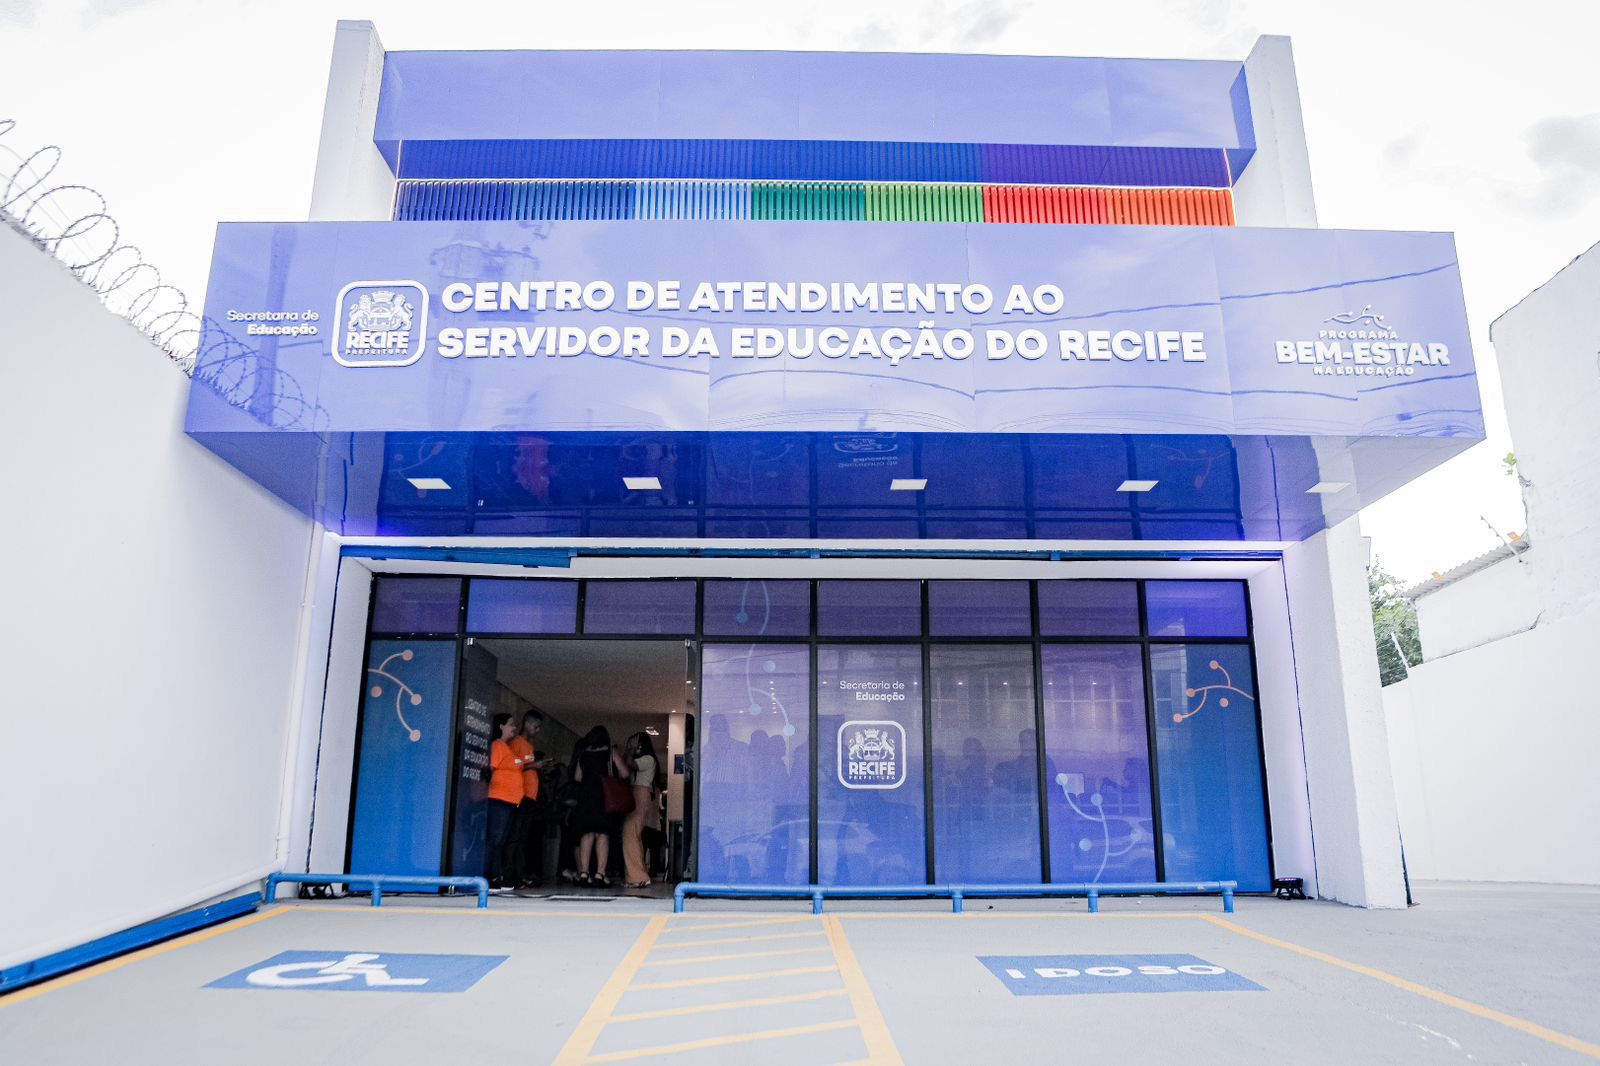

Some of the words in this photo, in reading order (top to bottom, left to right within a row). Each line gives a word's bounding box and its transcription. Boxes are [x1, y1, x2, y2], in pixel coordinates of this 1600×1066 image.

[441, 281, 615, 312] CENTRO
[626, 280, 681, 311] DE
[688, 281, 993, 314] ATENDIMENTO
[1002, 284, 1064, 315] AO
[227, 309, 298, 322] Secretaria
[301, 309, 320, 322] de
[247, 323, 319, 337] Educação
[1319, 330, 1399, 340] PROGRAMA
[345, 331, 410, 349] RECIFE
[437, 326, 650, 359] SERVIDOR
[662, 327, 720, 358] DA
[731, 320, 975, 366] EDUCAÇÃO
[986, 329, 1048, 361] DO
[1058, 330, 1207, 362] RECIFE
[1275, 340, 1451, 366] BEM-ESTAR
[1313, 366, 1335, 376] NA
[1336, 364, 1415, 378] EDUCAÇÃO
[839, 680, 890, 690] Secretaria
[892, 680, 905, 690] de
[855, 691, 905, 703] Educação
[848, 761, 896, 776] RECIFE
[1005, 965, 1226, 980] IDOSO
